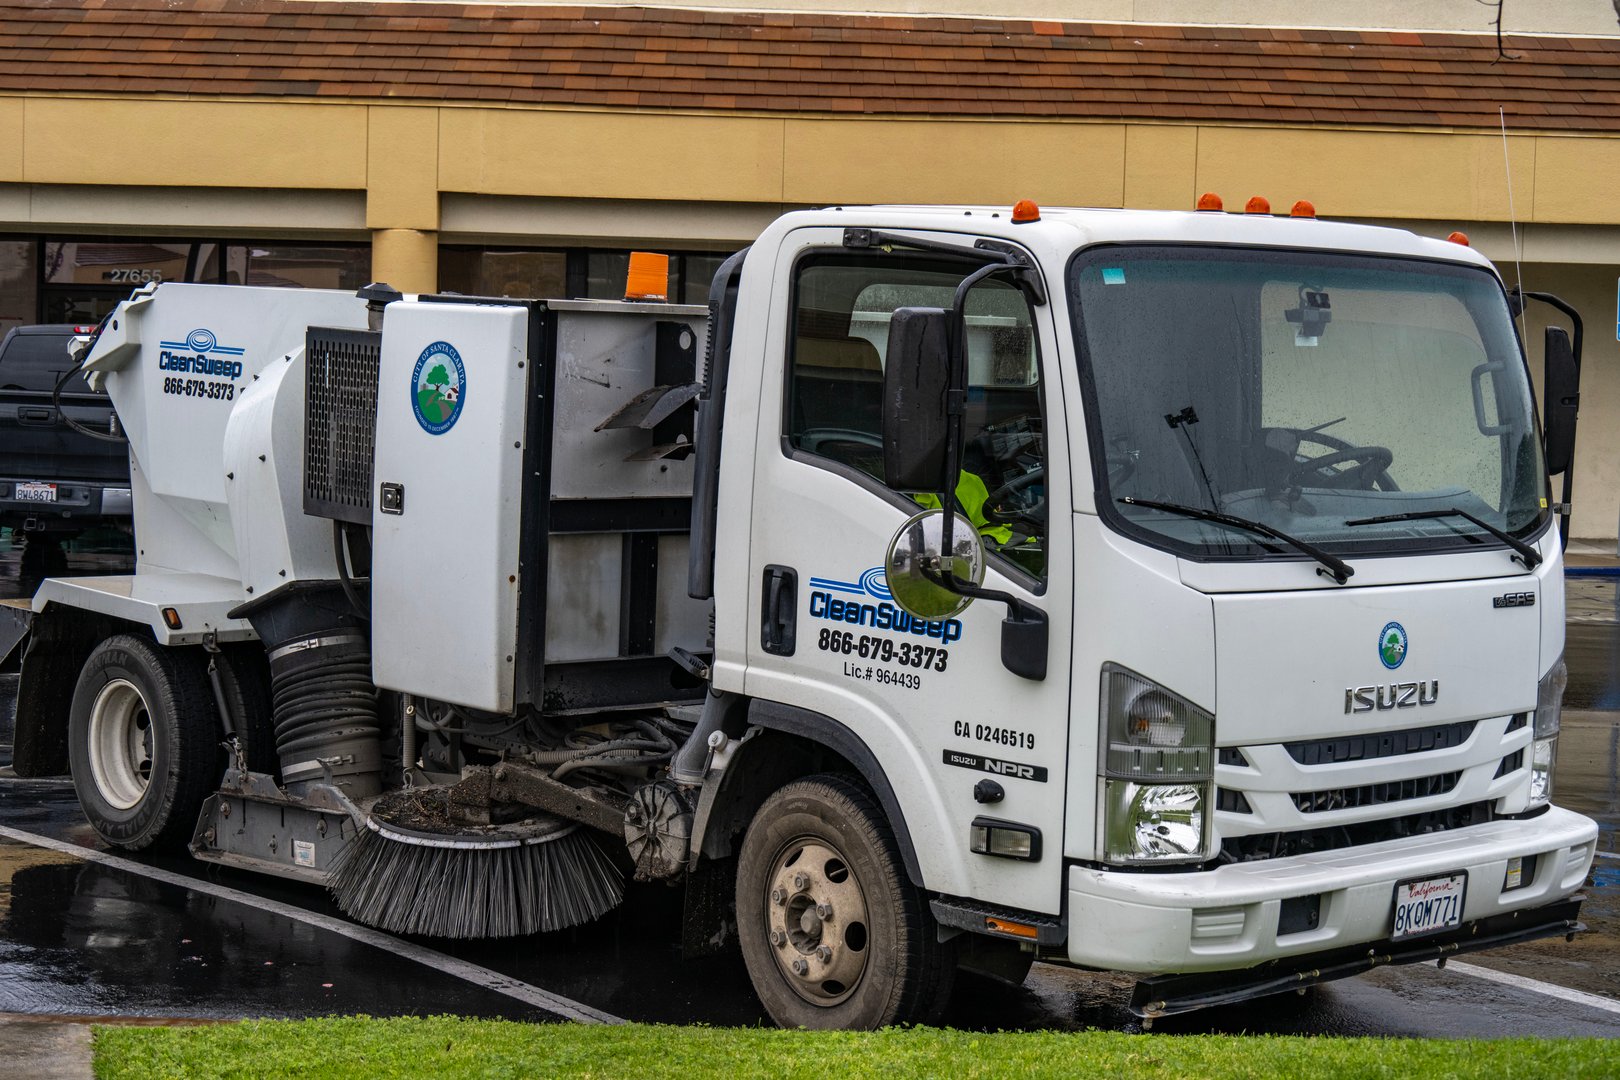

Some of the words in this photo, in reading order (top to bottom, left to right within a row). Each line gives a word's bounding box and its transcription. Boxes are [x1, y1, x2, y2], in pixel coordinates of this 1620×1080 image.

[111, 268, 162, 283] 27655
[159, 351, 243, 380] CleanSweep
[413, 360, 423, 383] CITY
[421, 349, 430, 361] OF
[430, 343, 449, 354] SANTA
[449, 349, 465, 385] CLARITA
[164, 377, 235, 401] 866-679-3373
[818, 628, 949, 672] 866-679-3373
[844, 661, 873, 681] Lic.#
[876, 668, 921, 690] 964439
[1344, 679, 1439, 715] ISUZU
[954, 720, 971, 738] CA
[975, 724, 1035, 750] 0246519
[951, 755, 976, 766] ISUZU
[984, 759, 1034, 779] NPR
[1409, 882, 1453, 899] California
[1396, 894, 1458, 932] 8KQM771
